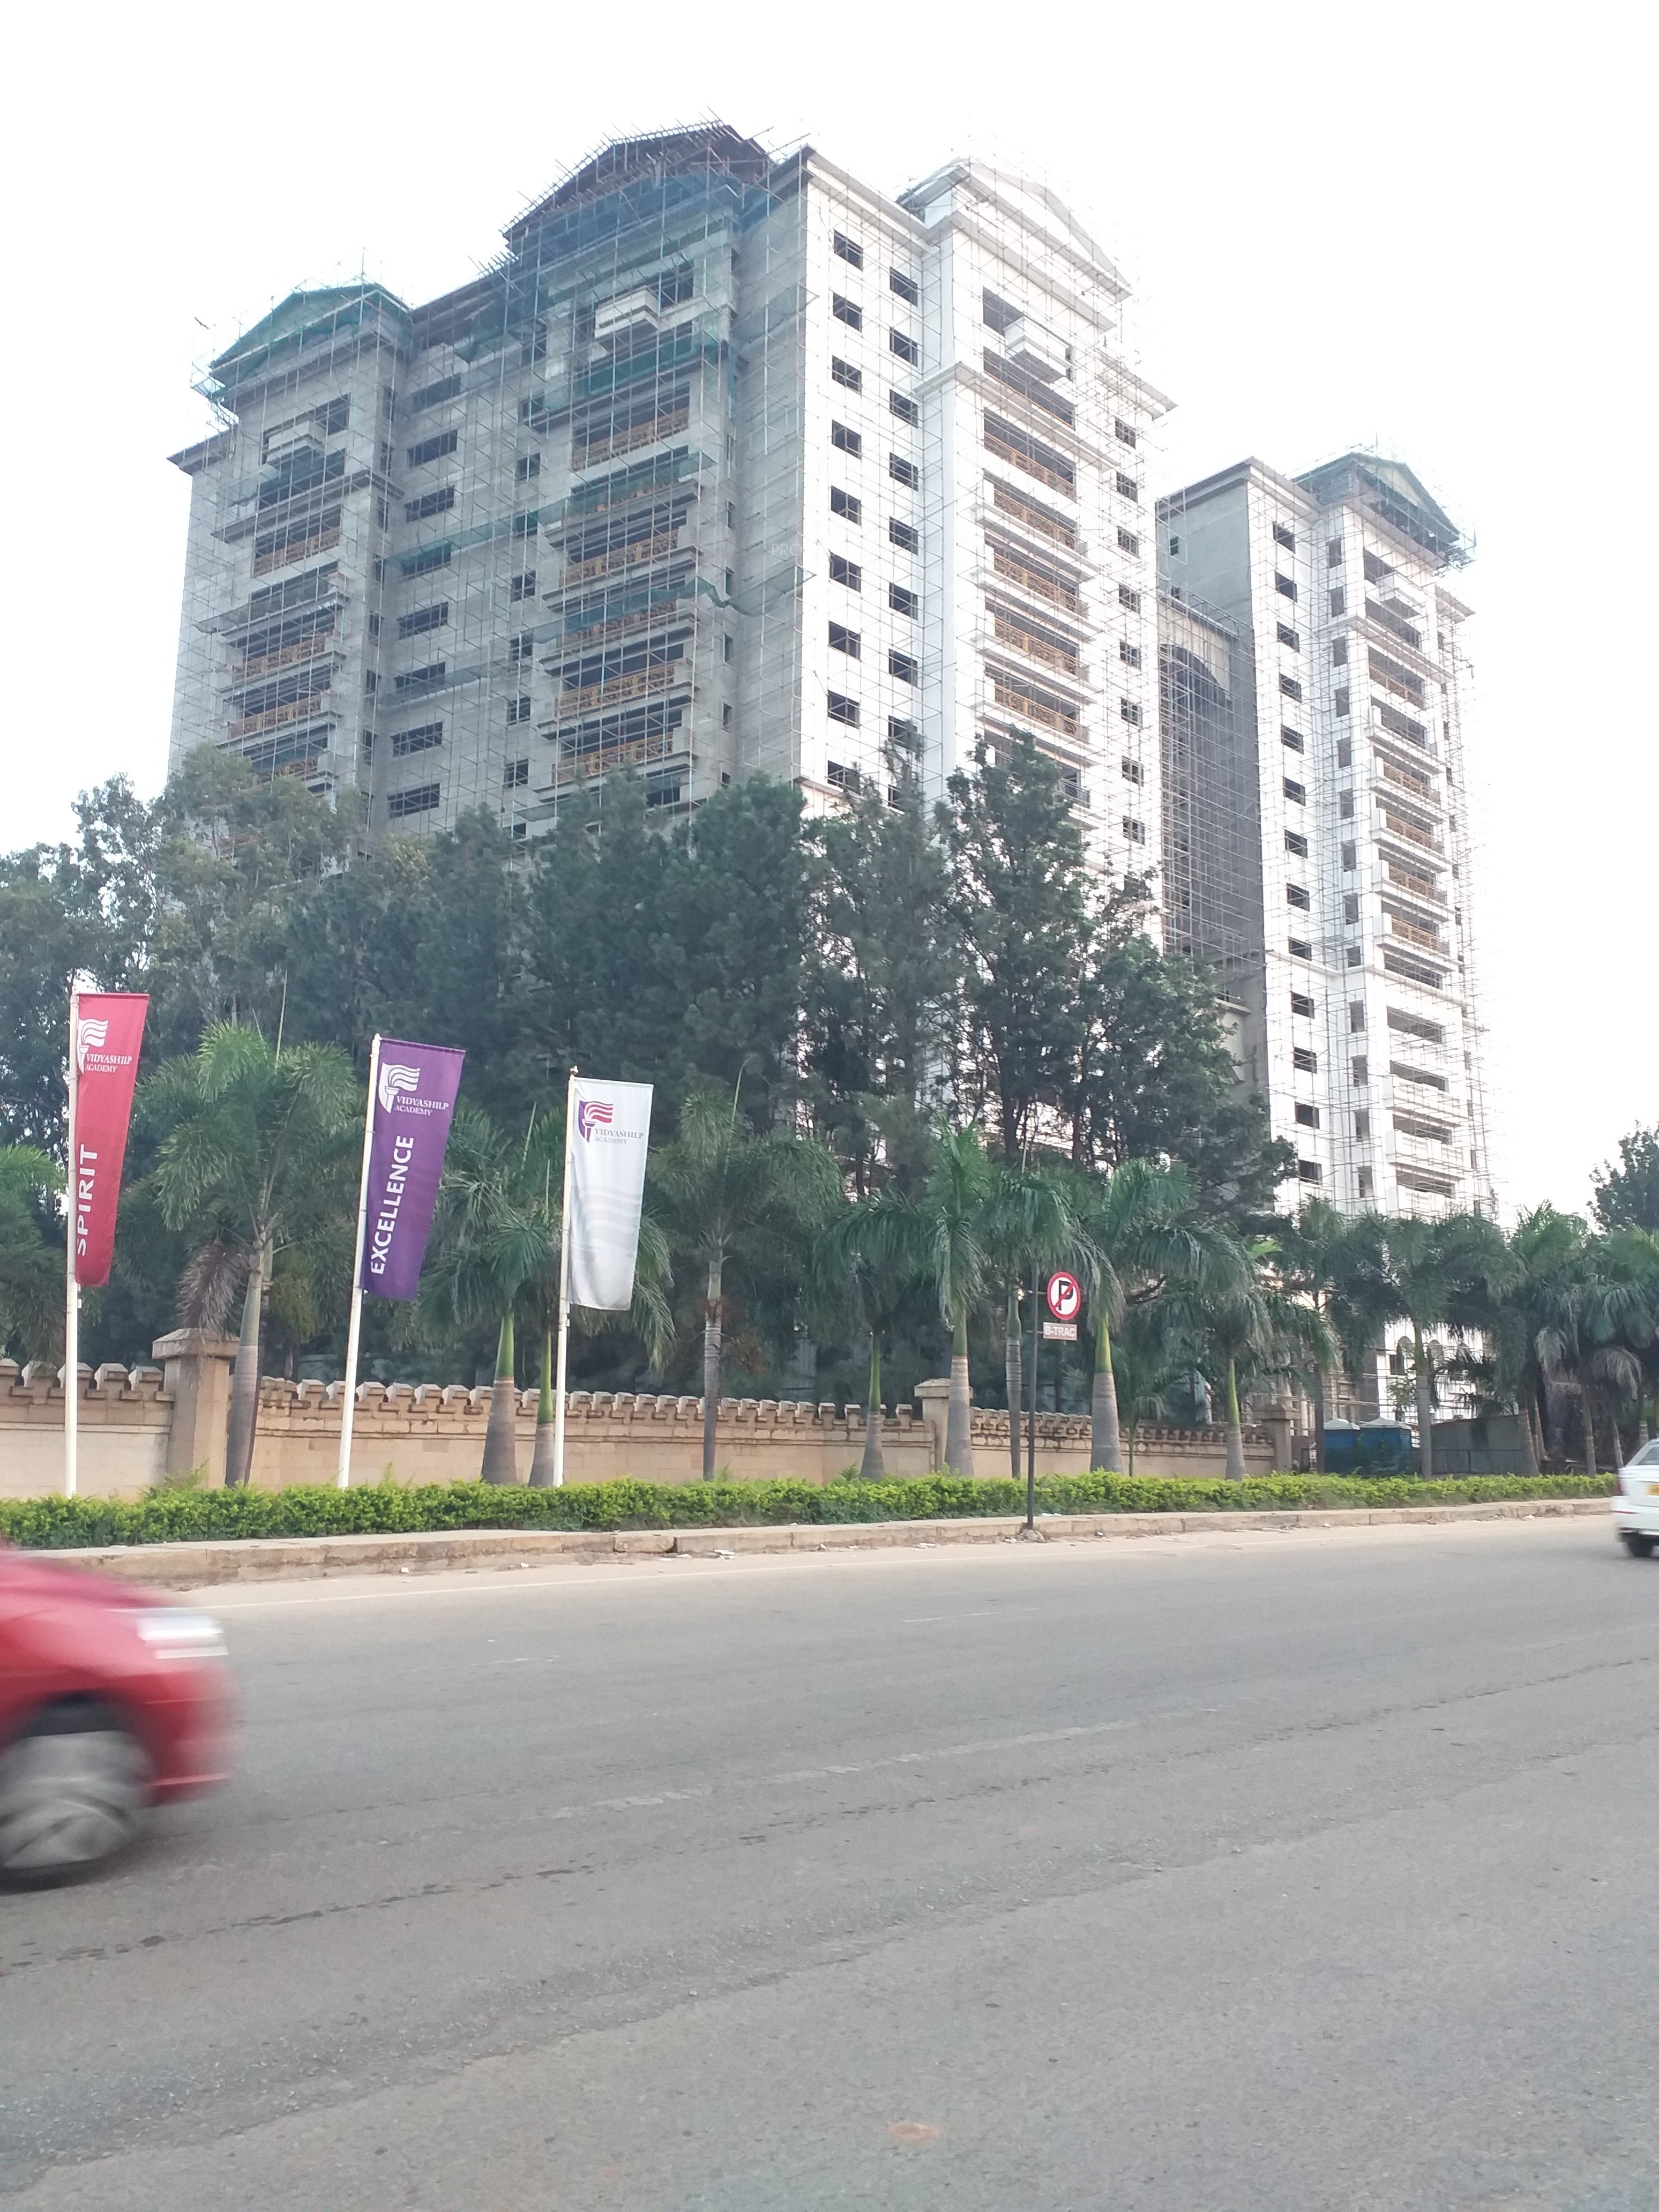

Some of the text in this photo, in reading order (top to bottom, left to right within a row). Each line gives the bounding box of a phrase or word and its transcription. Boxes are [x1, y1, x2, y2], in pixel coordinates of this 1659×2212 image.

[86, 1053, 132, 1065] VIDYASHILP
[85, 1063, 117, 1073] ACADEMY
[397, 1095, 449, 1110] VIDYASHILP
[394, 1104, 432, 1116] ACADEMY
[595, 1128, 644, 1139] VIDYASHILP
[594, 1137, 627, 1145] ACADEMY
[77, 1144, 98, 1257] SPIRIT
[370, 1135, 414, 1274] EXCELLENCE
[1044, 1326, 1076, 1337] B-TRAC
